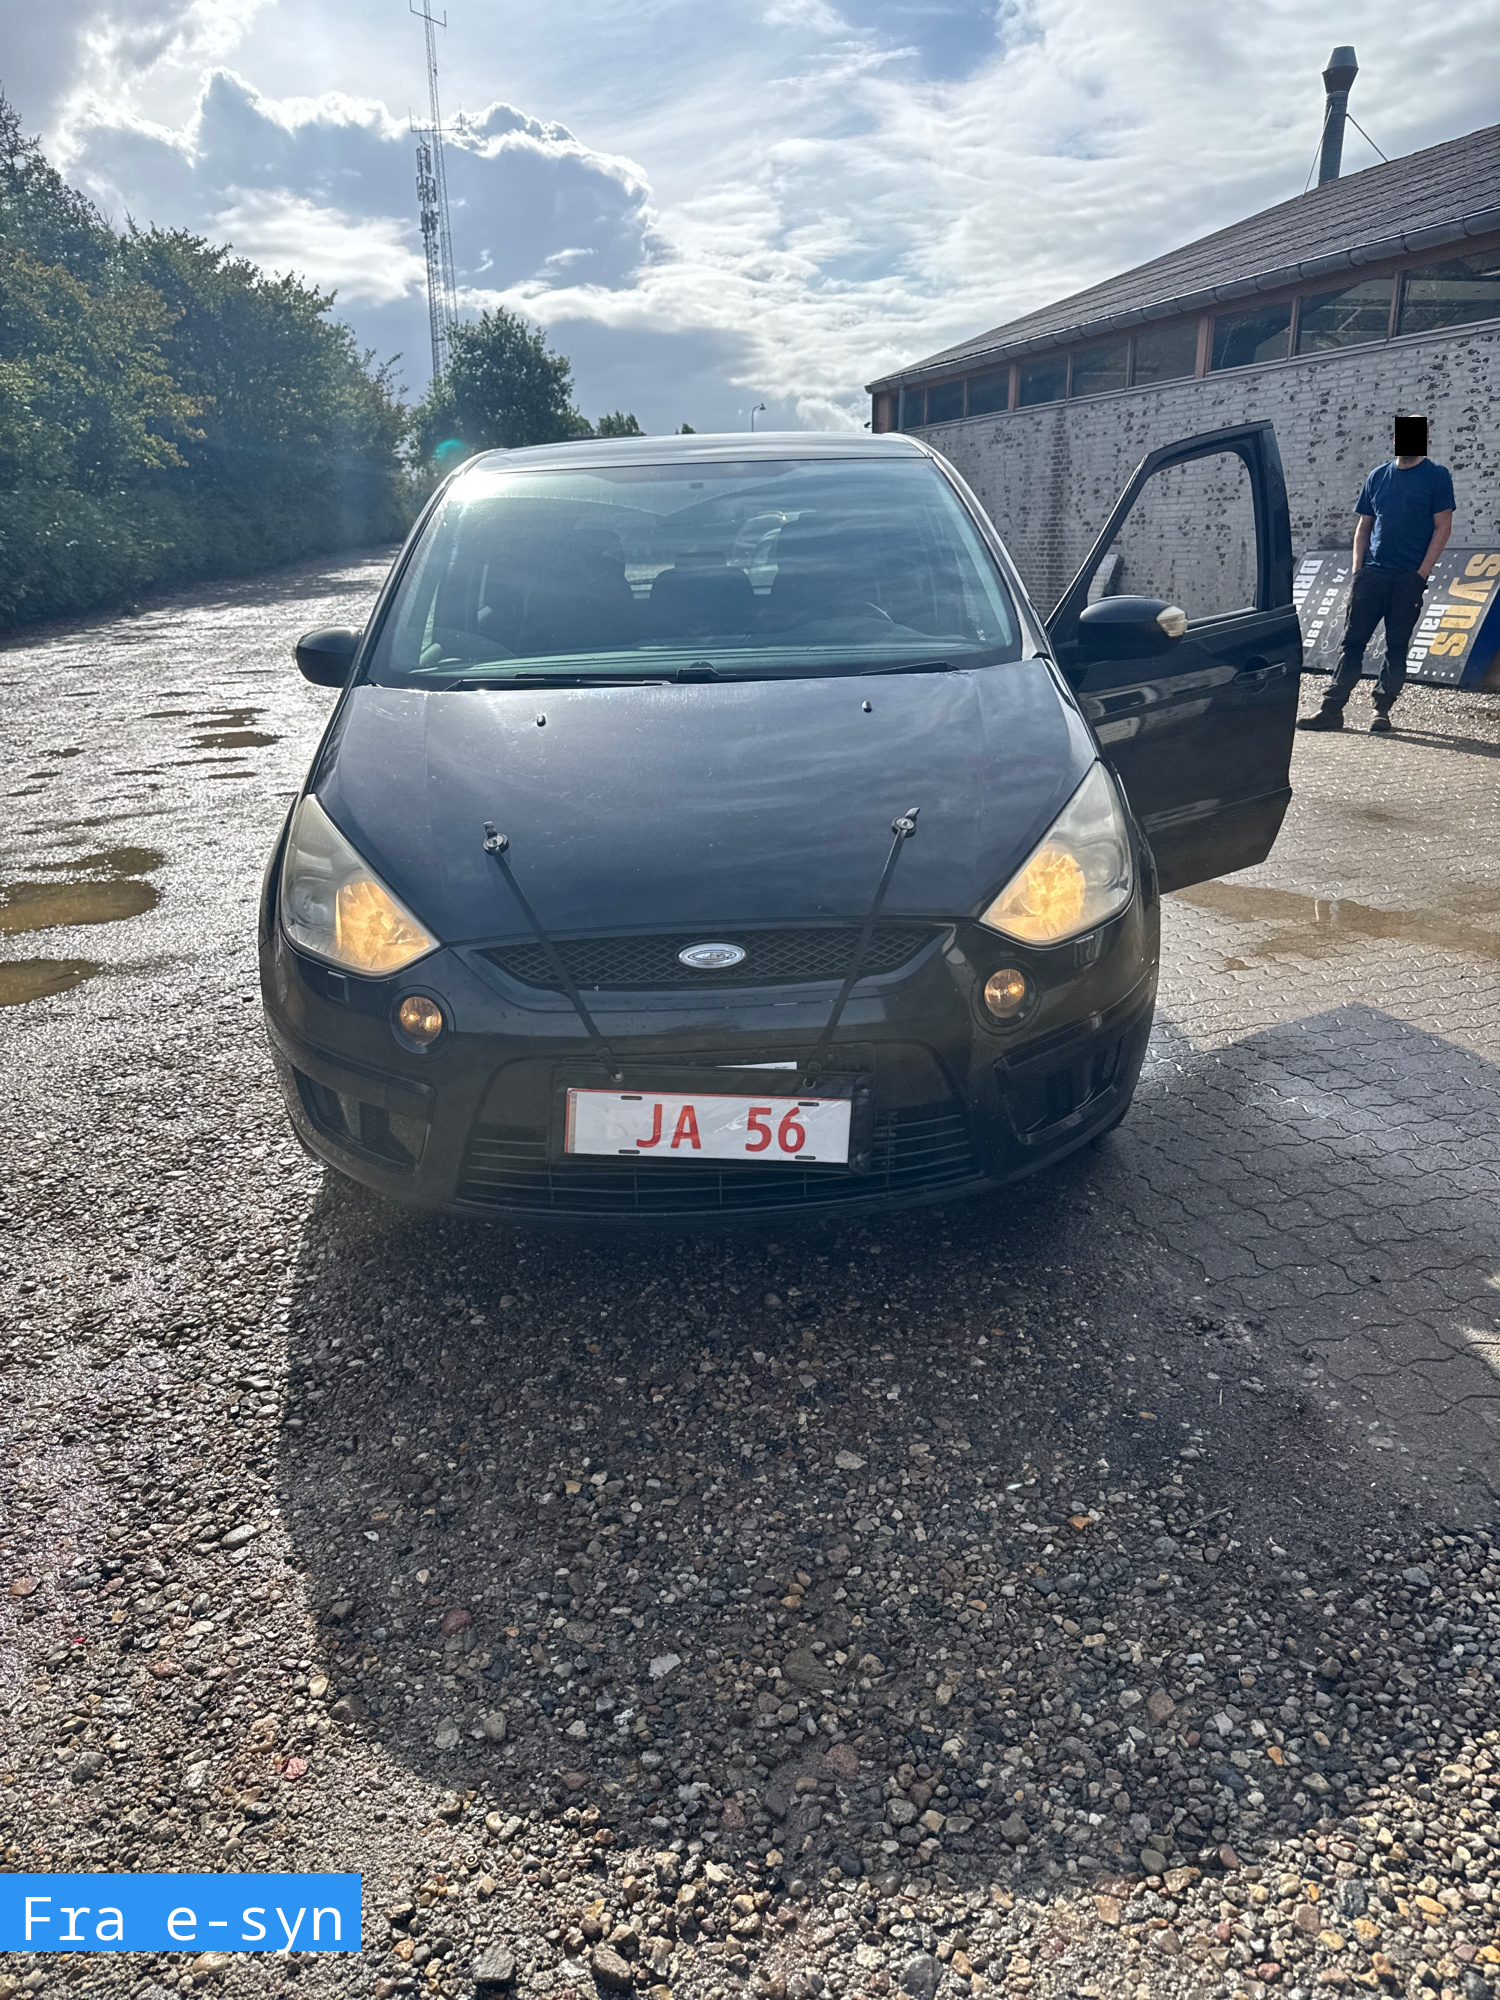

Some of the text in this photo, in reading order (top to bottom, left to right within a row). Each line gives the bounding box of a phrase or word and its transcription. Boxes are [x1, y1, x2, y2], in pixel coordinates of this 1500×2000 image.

[1303, 568, 1349, 648] 74 830 890
[1406, 604, 1452, 674] hallen
[636, 1104, 806, 1153] JA 56
